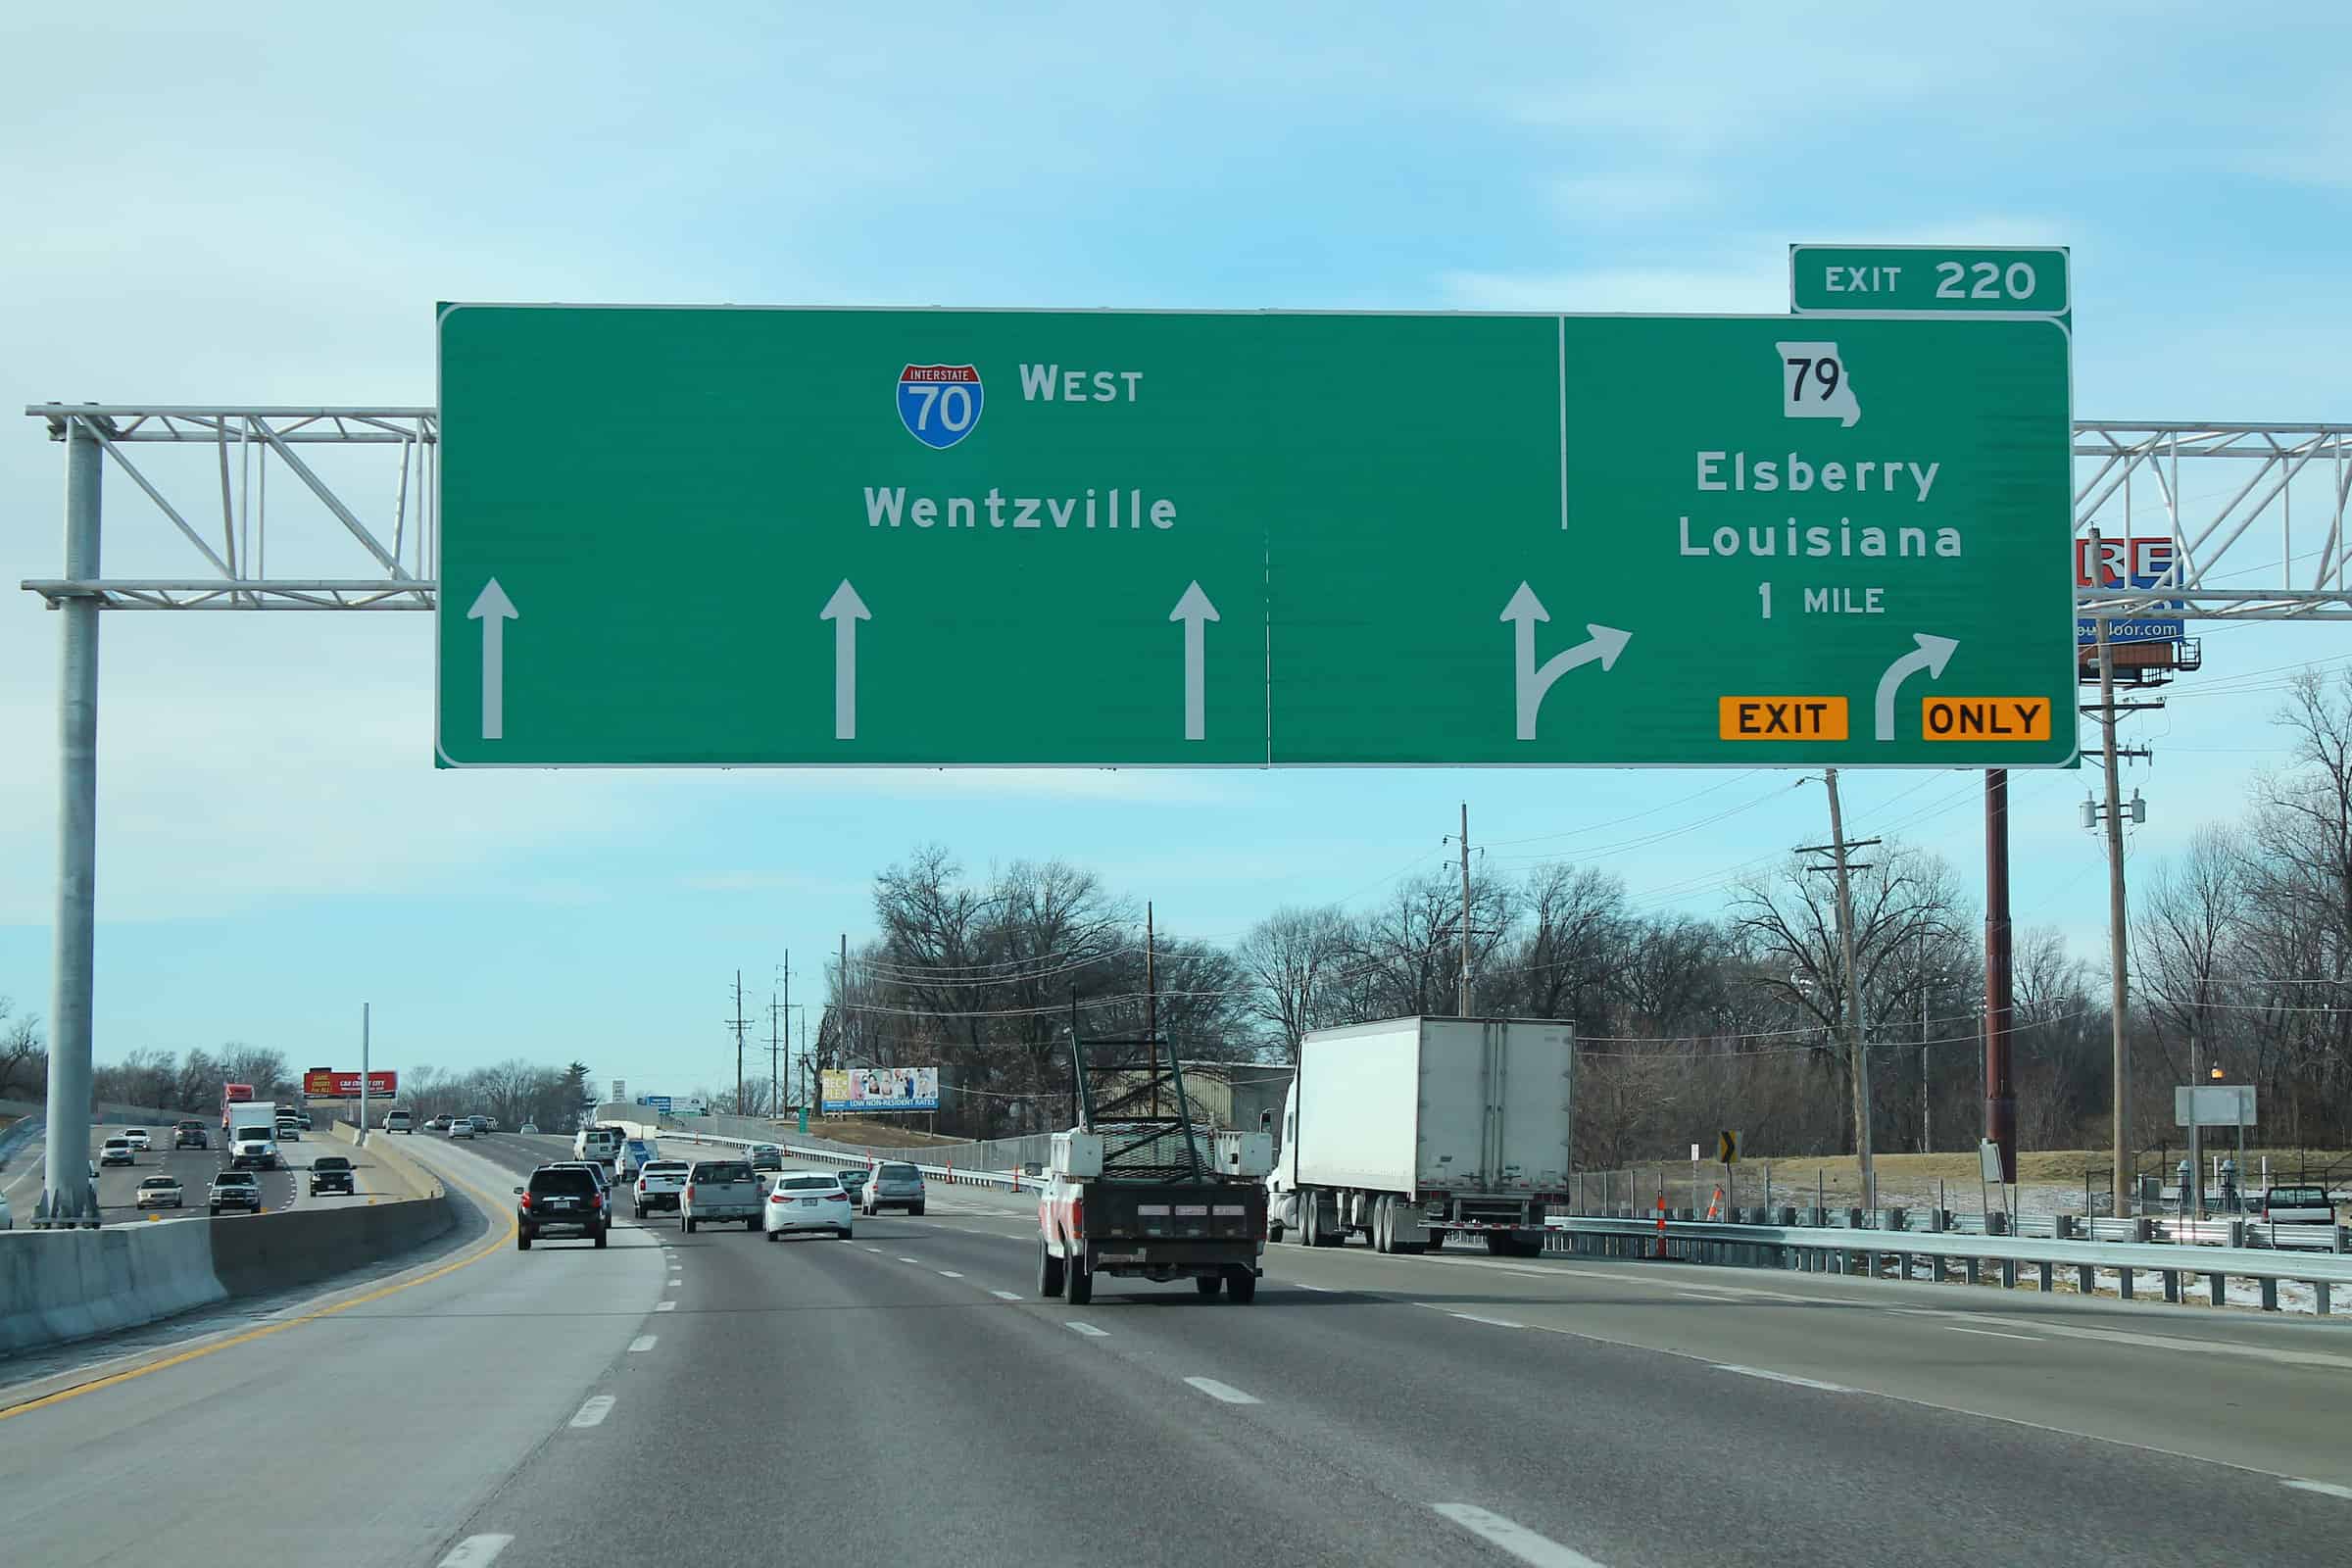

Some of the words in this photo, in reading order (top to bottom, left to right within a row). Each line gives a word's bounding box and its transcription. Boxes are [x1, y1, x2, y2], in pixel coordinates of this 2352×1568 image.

[1826, 267, 1901, 292] EXIT
[1936, 261, 2035, 300] 220
[910, 369, 969, 381] INTERSTATE
[1019, 364, 1143, 402] WEST
[1788, 358, 1839, 402] 79
[908, 385, 971, 431] 70
[1696, 451, 1939, 502] Elsberry
[864, 486, 1177, 529] Wentzville
[1680, 516, 1961, 557] Louisiana
[1758, 582, 1772, 618] 1
[1804, 588, 1885, 613] MILE
[1740, 704, 1828, 733] EXIT
[1929, 704, 2040, 734] ONLY
